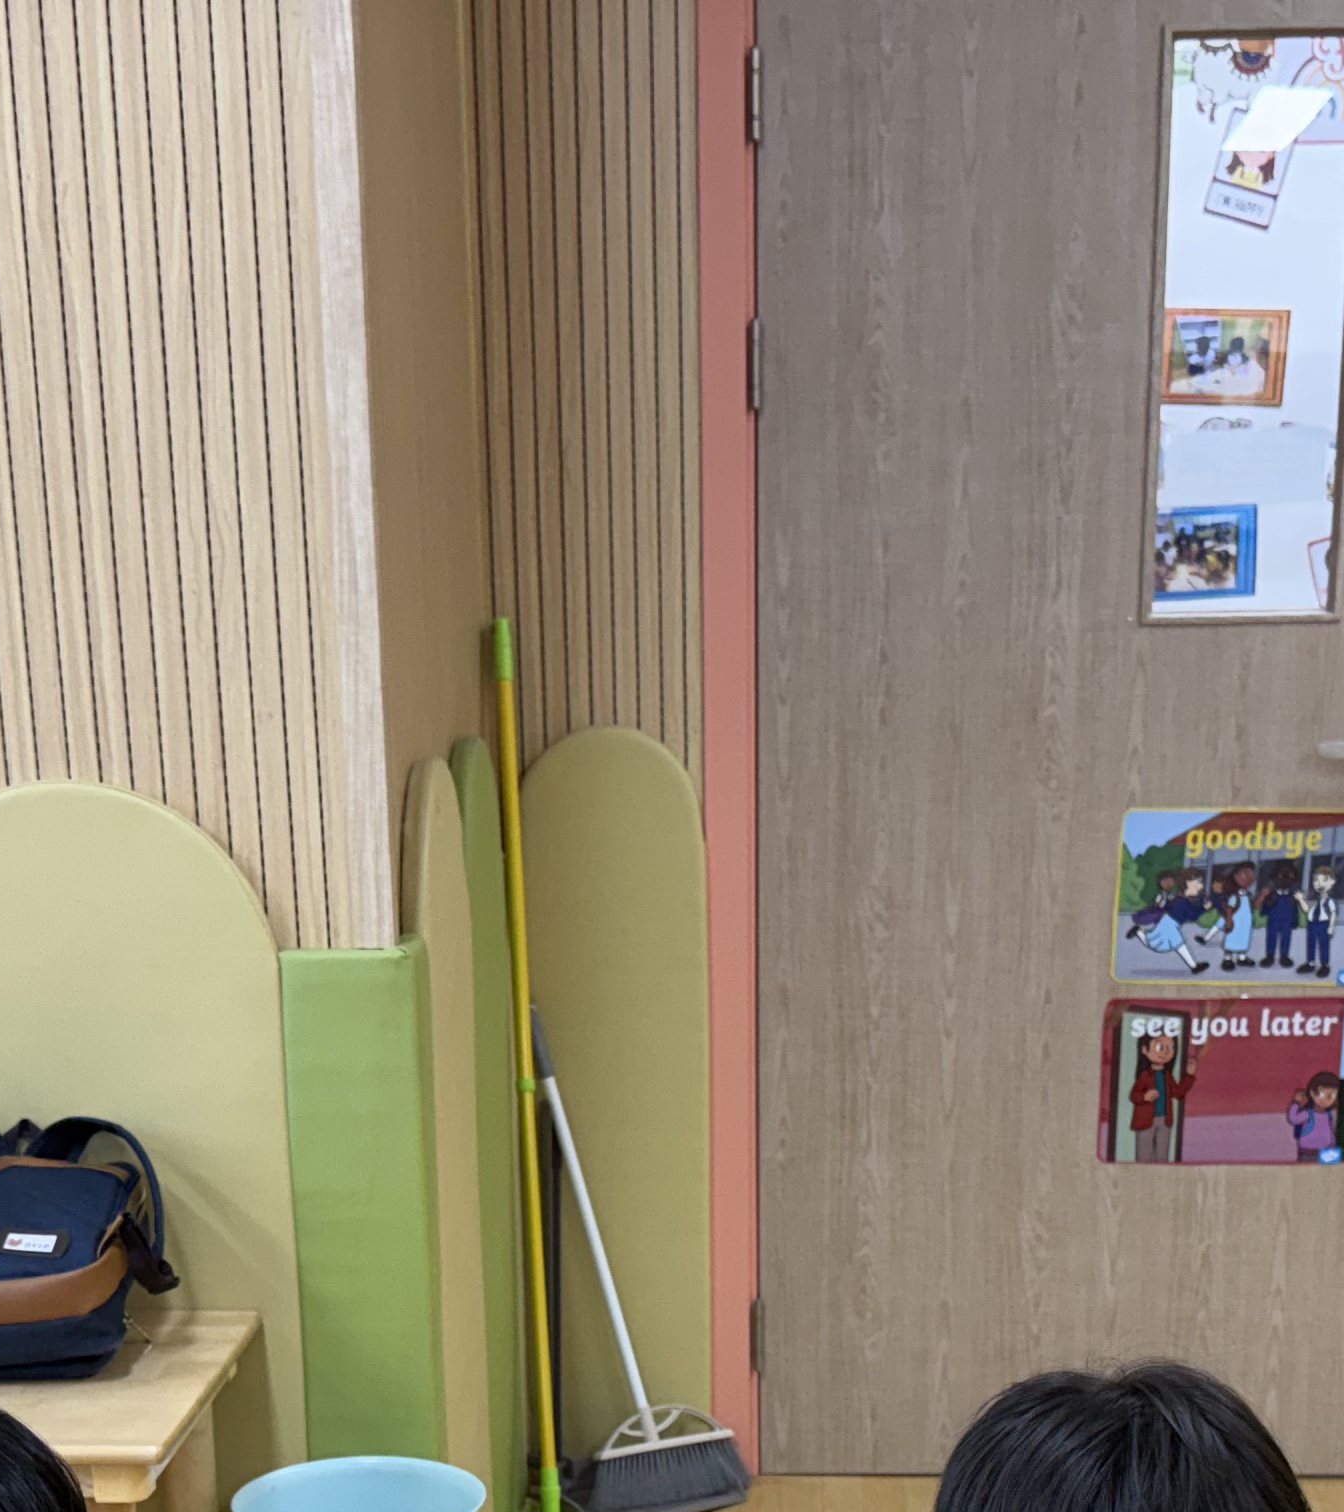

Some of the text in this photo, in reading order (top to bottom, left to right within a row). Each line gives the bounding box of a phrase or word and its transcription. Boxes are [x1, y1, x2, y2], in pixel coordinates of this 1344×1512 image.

[1186, 820, 1323, 859] goodbye
[1130, 1008, 1339, 1045] see you later
